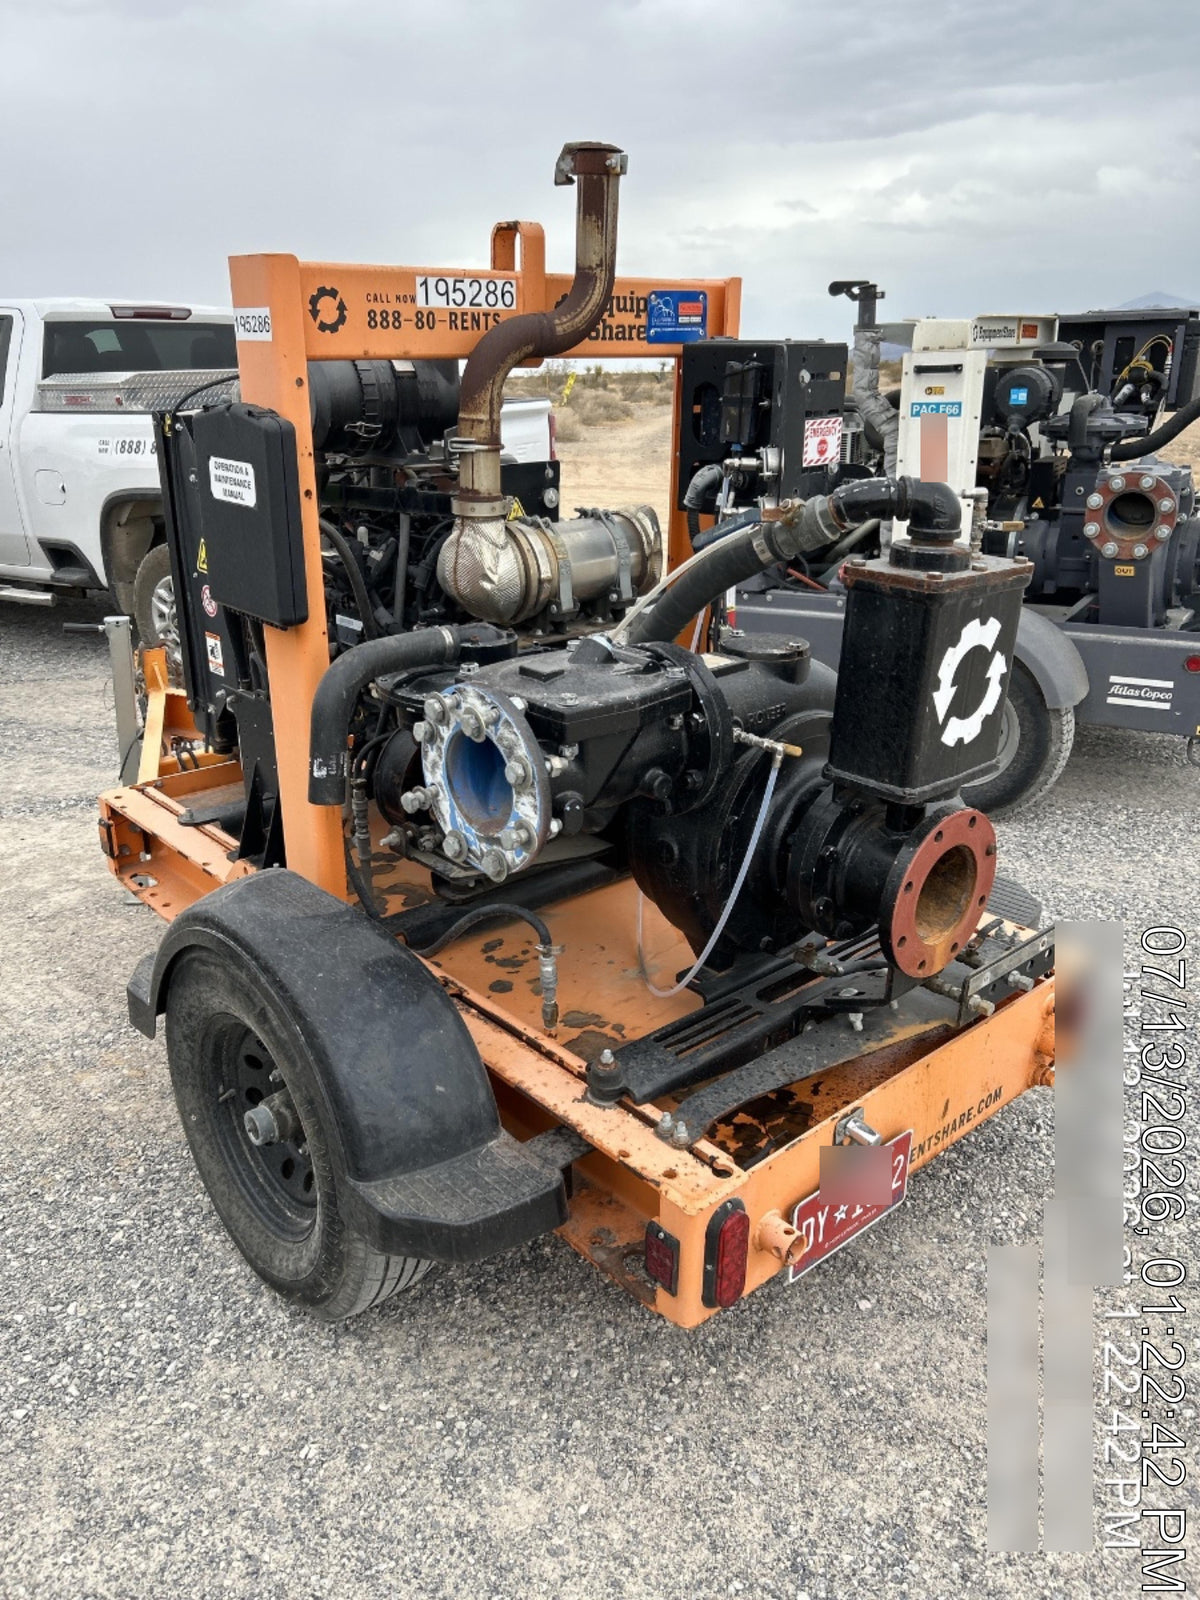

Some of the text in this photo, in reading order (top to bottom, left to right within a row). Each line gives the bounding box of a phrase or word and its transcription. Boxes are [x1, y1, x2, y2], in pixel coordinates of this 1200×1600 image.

[366, 292, 416, 304] CALL NOW
[419, 277, 515, 308] 195286
[234, 315, 270, 333] 195286
[367, 309, 501, 331] 888-80-RENTS
[912, 404, 937, 416] PAC
[115, 440, 146, 455] (888)
[1108, 685, 1173, 700] Atlas Copco
[910, 1086, 1003, 1164] ENTSHARE.COM
